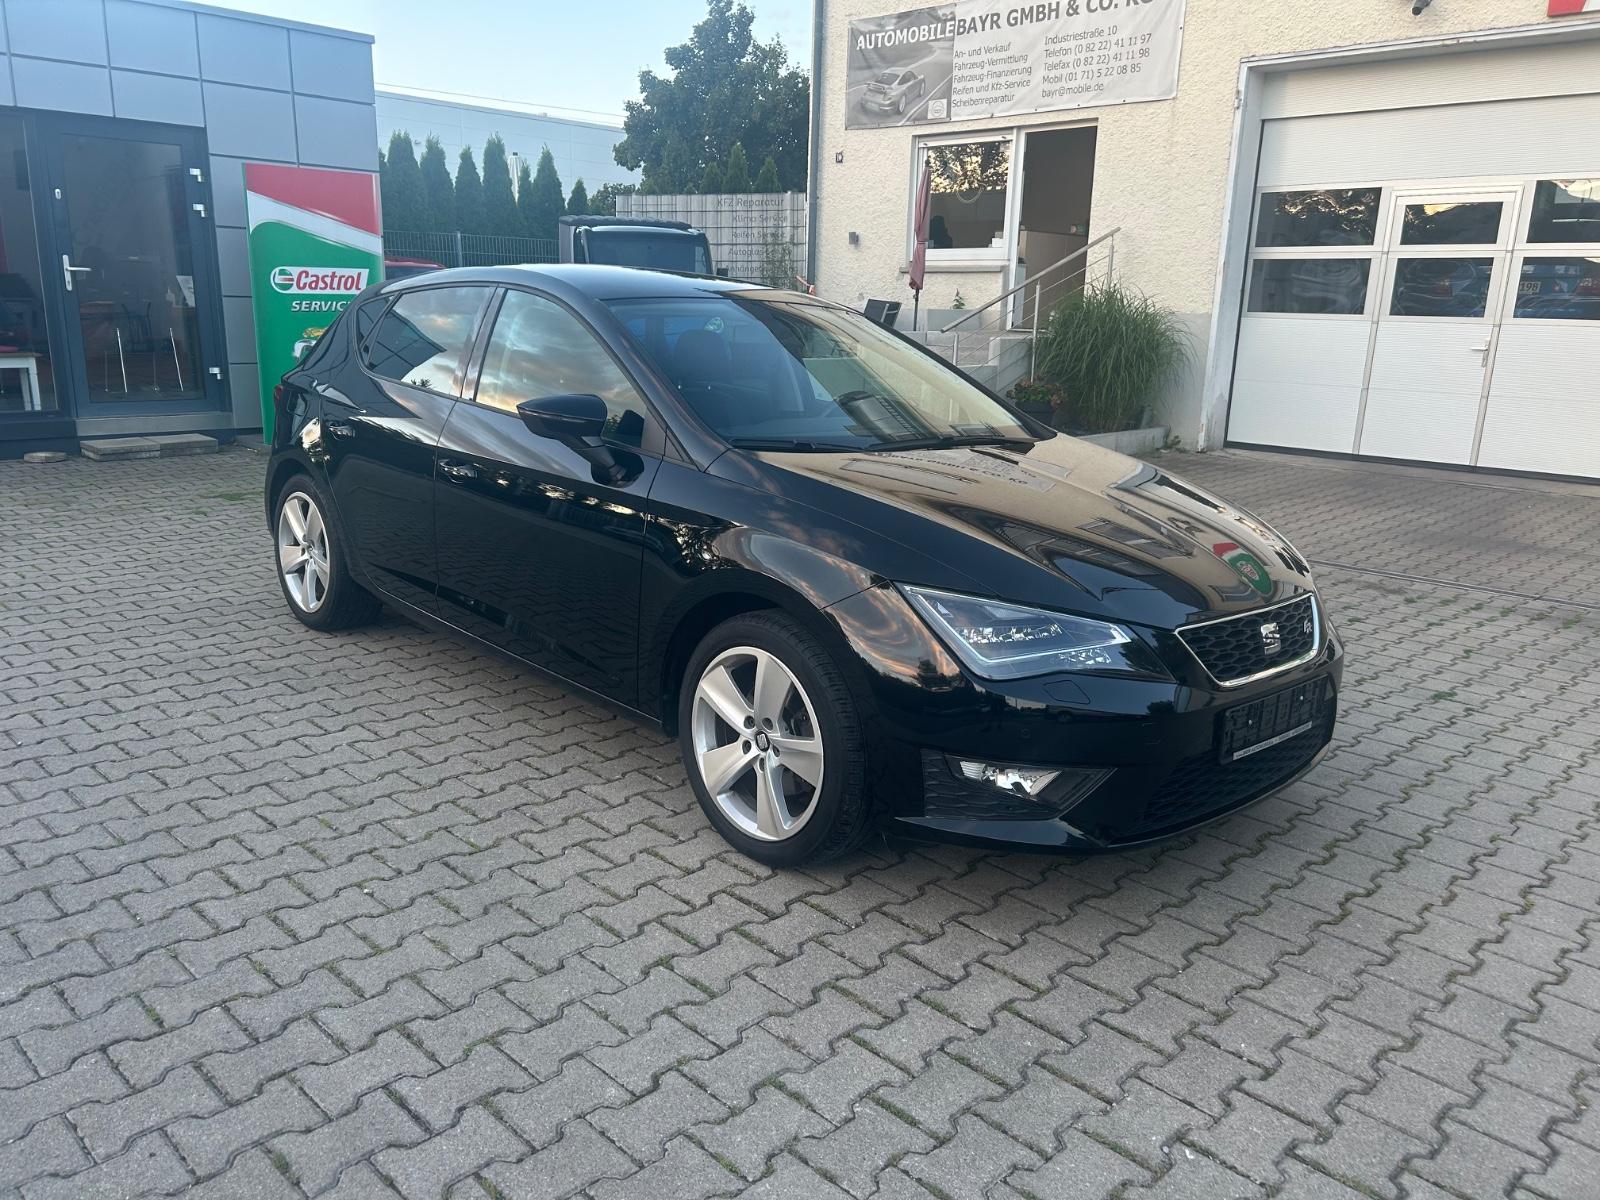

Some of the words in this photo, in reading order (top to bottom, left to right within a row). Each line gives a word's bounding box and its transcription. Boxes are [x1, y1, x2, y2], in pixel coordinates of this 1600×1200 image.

[856, 20, 955, 50] AUTOMOBILE
[957, 12, 1001, 35] BAYR
[1007, 1, 1060, 27] GMBH
[1066, 0, 1080, 17] &
[1044, 27, 1105, 45] Industriestraße
[1107, 25, 1118, 36] 10
[954, 50, 966, 58] An-
[968, 47, 982, 57] und
[983, 41, 1011, 54] Verkauf
[1044, 47, 1072, 58] Telefon
[1074, 44, 1083, 56] (0
[1085, 42, 1096, 53] 82
[1097, 40, 1112, 51] 22)
[1114, 38, 1124, 48] 41
[1128, 36, 1138, 46] 11
[1140, 33, 1152, 44] 97
[954, 54, 1028, 71] Fahrzeug-Vermittlung
[1043, 60, 1071, 71] Telefax
[1072, 58, 1081, 70] (0
[1083, 56, 1094, 67] 82
[1096, 53, 1110, 65] 22)
[1112, 52, 1122, 62] 41
[1126, 50, 1135, 60] 11
[1138, 47, 1150, 58] 98
[953, 66, 1032, 83] Fahrzeug-Finanzierung
[1042, 73, 1063, 84] Mobil
[1064, 71, 1078, 84] (01
[1081, 69, 1094, 81] 71)
[1096, 68, 1102, 78] 5
[1103, 67, 1115, 77] 22
[1116, 64, 1127, 75] 08
[1130, 62, 1141, 73] 85
[953, 85, 974, 95] Reifen
[975, 83, 989, 93] und
[991, 79, 1031, 91] Kfz-Service
[1041, 82, 1104, 98] bayr@mobile.de
[952, 93, 1015, 108] Scheibenreparatur
[737, 197, 784, 208] Reparatur
[731, 230, 755, 239] Reifen
[296, 270, 361, 291] Castrol
[291, 300, 351, 312] SERVIC
